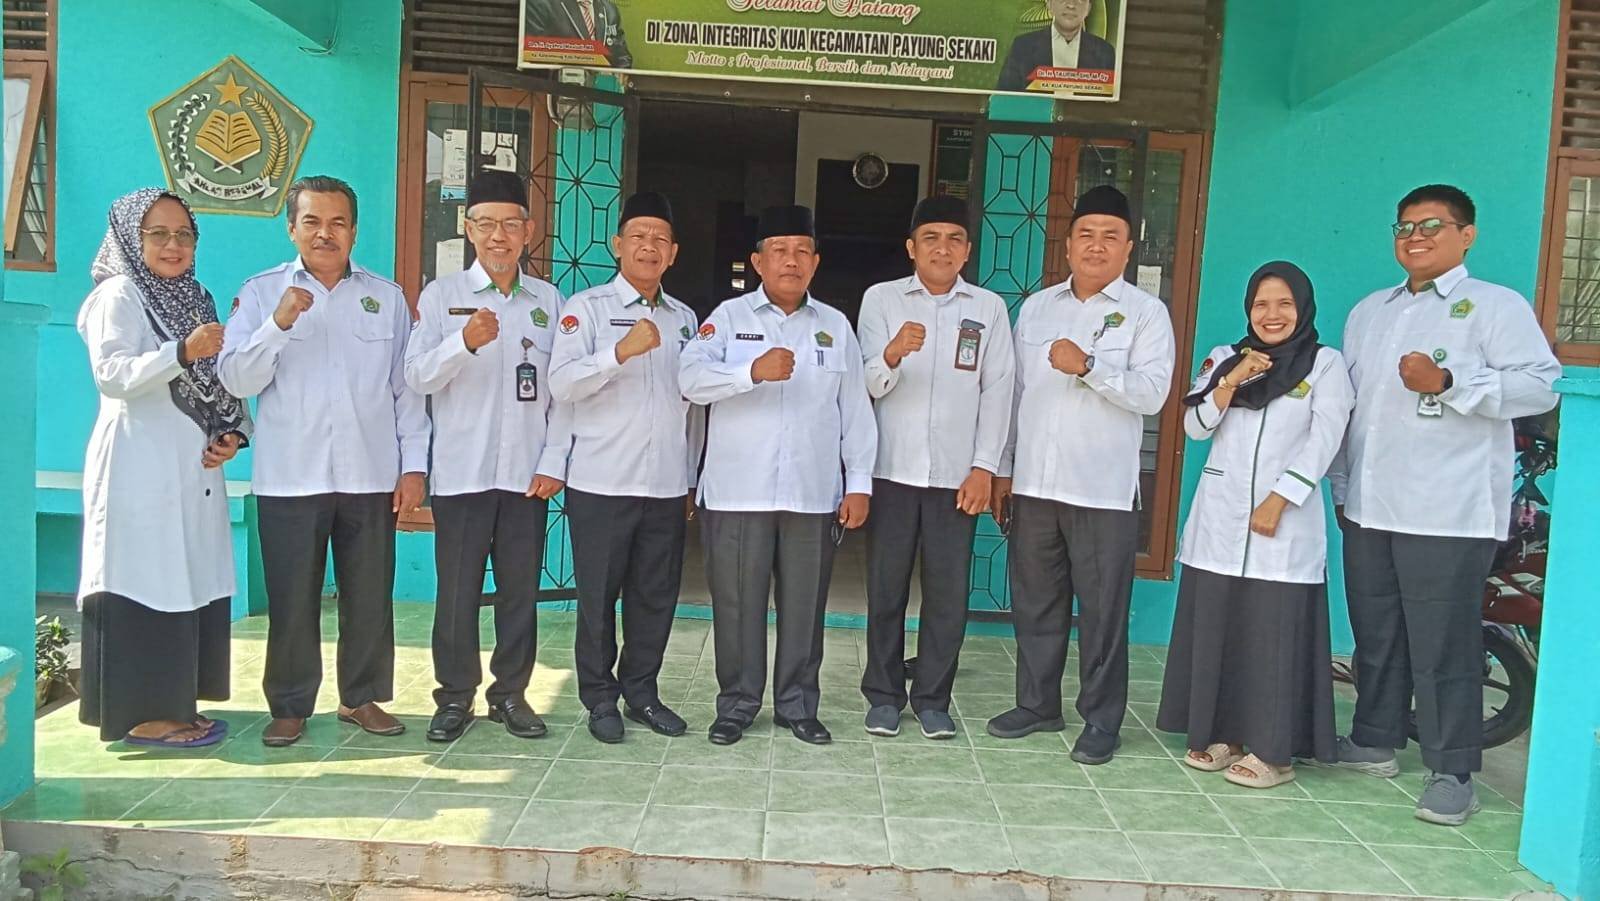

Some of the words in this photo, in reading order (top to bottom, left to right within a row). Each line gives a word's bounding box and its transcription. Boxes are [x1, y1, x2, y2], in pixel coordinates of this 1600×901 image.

[646, 20, 661, 43] DI
[663, 21, 699, 45] ZONA
[701, 23, 777, 50] INTEGRITAS
[779, 27, 807, 51] KUA
[809, 29, 890, 56] KECAMATAN
[893, 34, 945, 59] PAYUNG
[948, 37, 996, 62] SEKAKI
[686, 51, 726, 66] Motto
[736, 53, 815, 72] Profesional,
[816, 57, 859, 74] Bersih
[860, 60, 888, 75] dan
[889, 62, 954, 81] Melayani
